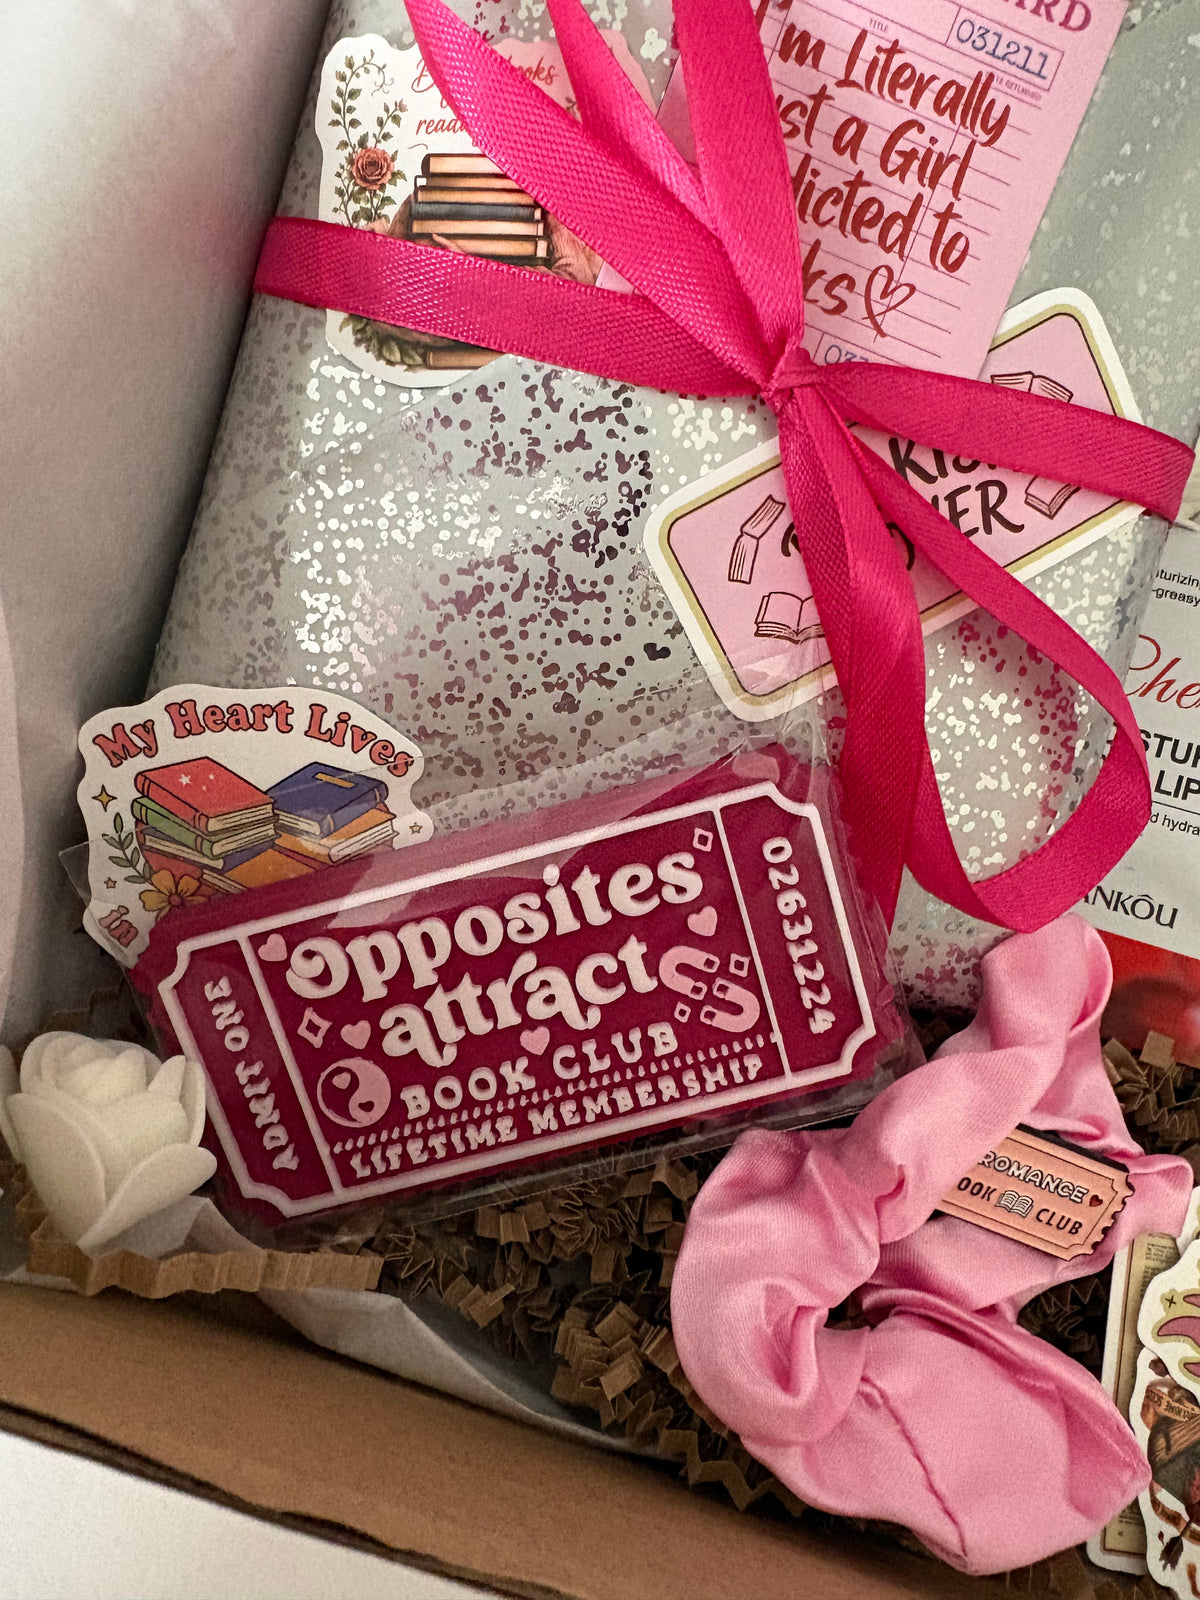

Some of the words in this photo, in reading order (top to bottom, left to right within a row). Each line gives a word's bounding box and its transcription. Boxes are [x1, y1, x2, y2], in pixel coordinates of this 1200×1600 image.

[957, 19, 1047, 80] 031211
[1003, 0, 1092, 32] RD
[835, 28, 1010, 148] Literally
[776, 84, 835, 148] st
[832, 115, 869, 165] a
[879, 119, 978, 201] Girl
[929, 201, 970, 274] to
[931, 479, 1025, 538] ER
[92, 719, 158, 768] My
[164, 699, 294, 739] Heart
[304, 703, 415, 777] Lives
[762, 837, 838, 1035] 02631224
[204, 976, 250, 1052] ONE
[379, 933, 659, 1068] attract
[399, 1056, 536, 1120] BOOK
[552, 1021, 679, 1080] CLUB
[235, 1060, 300, 1171] ADMIT
[350, 1115, 518, 1179] LIFETIME
[527, 1053, 763, 1135] MEMBERSHIP
[977, 1151, 1090, 1205] ROMANCE
[1035, 1208, 1083, 1235] CLUB
